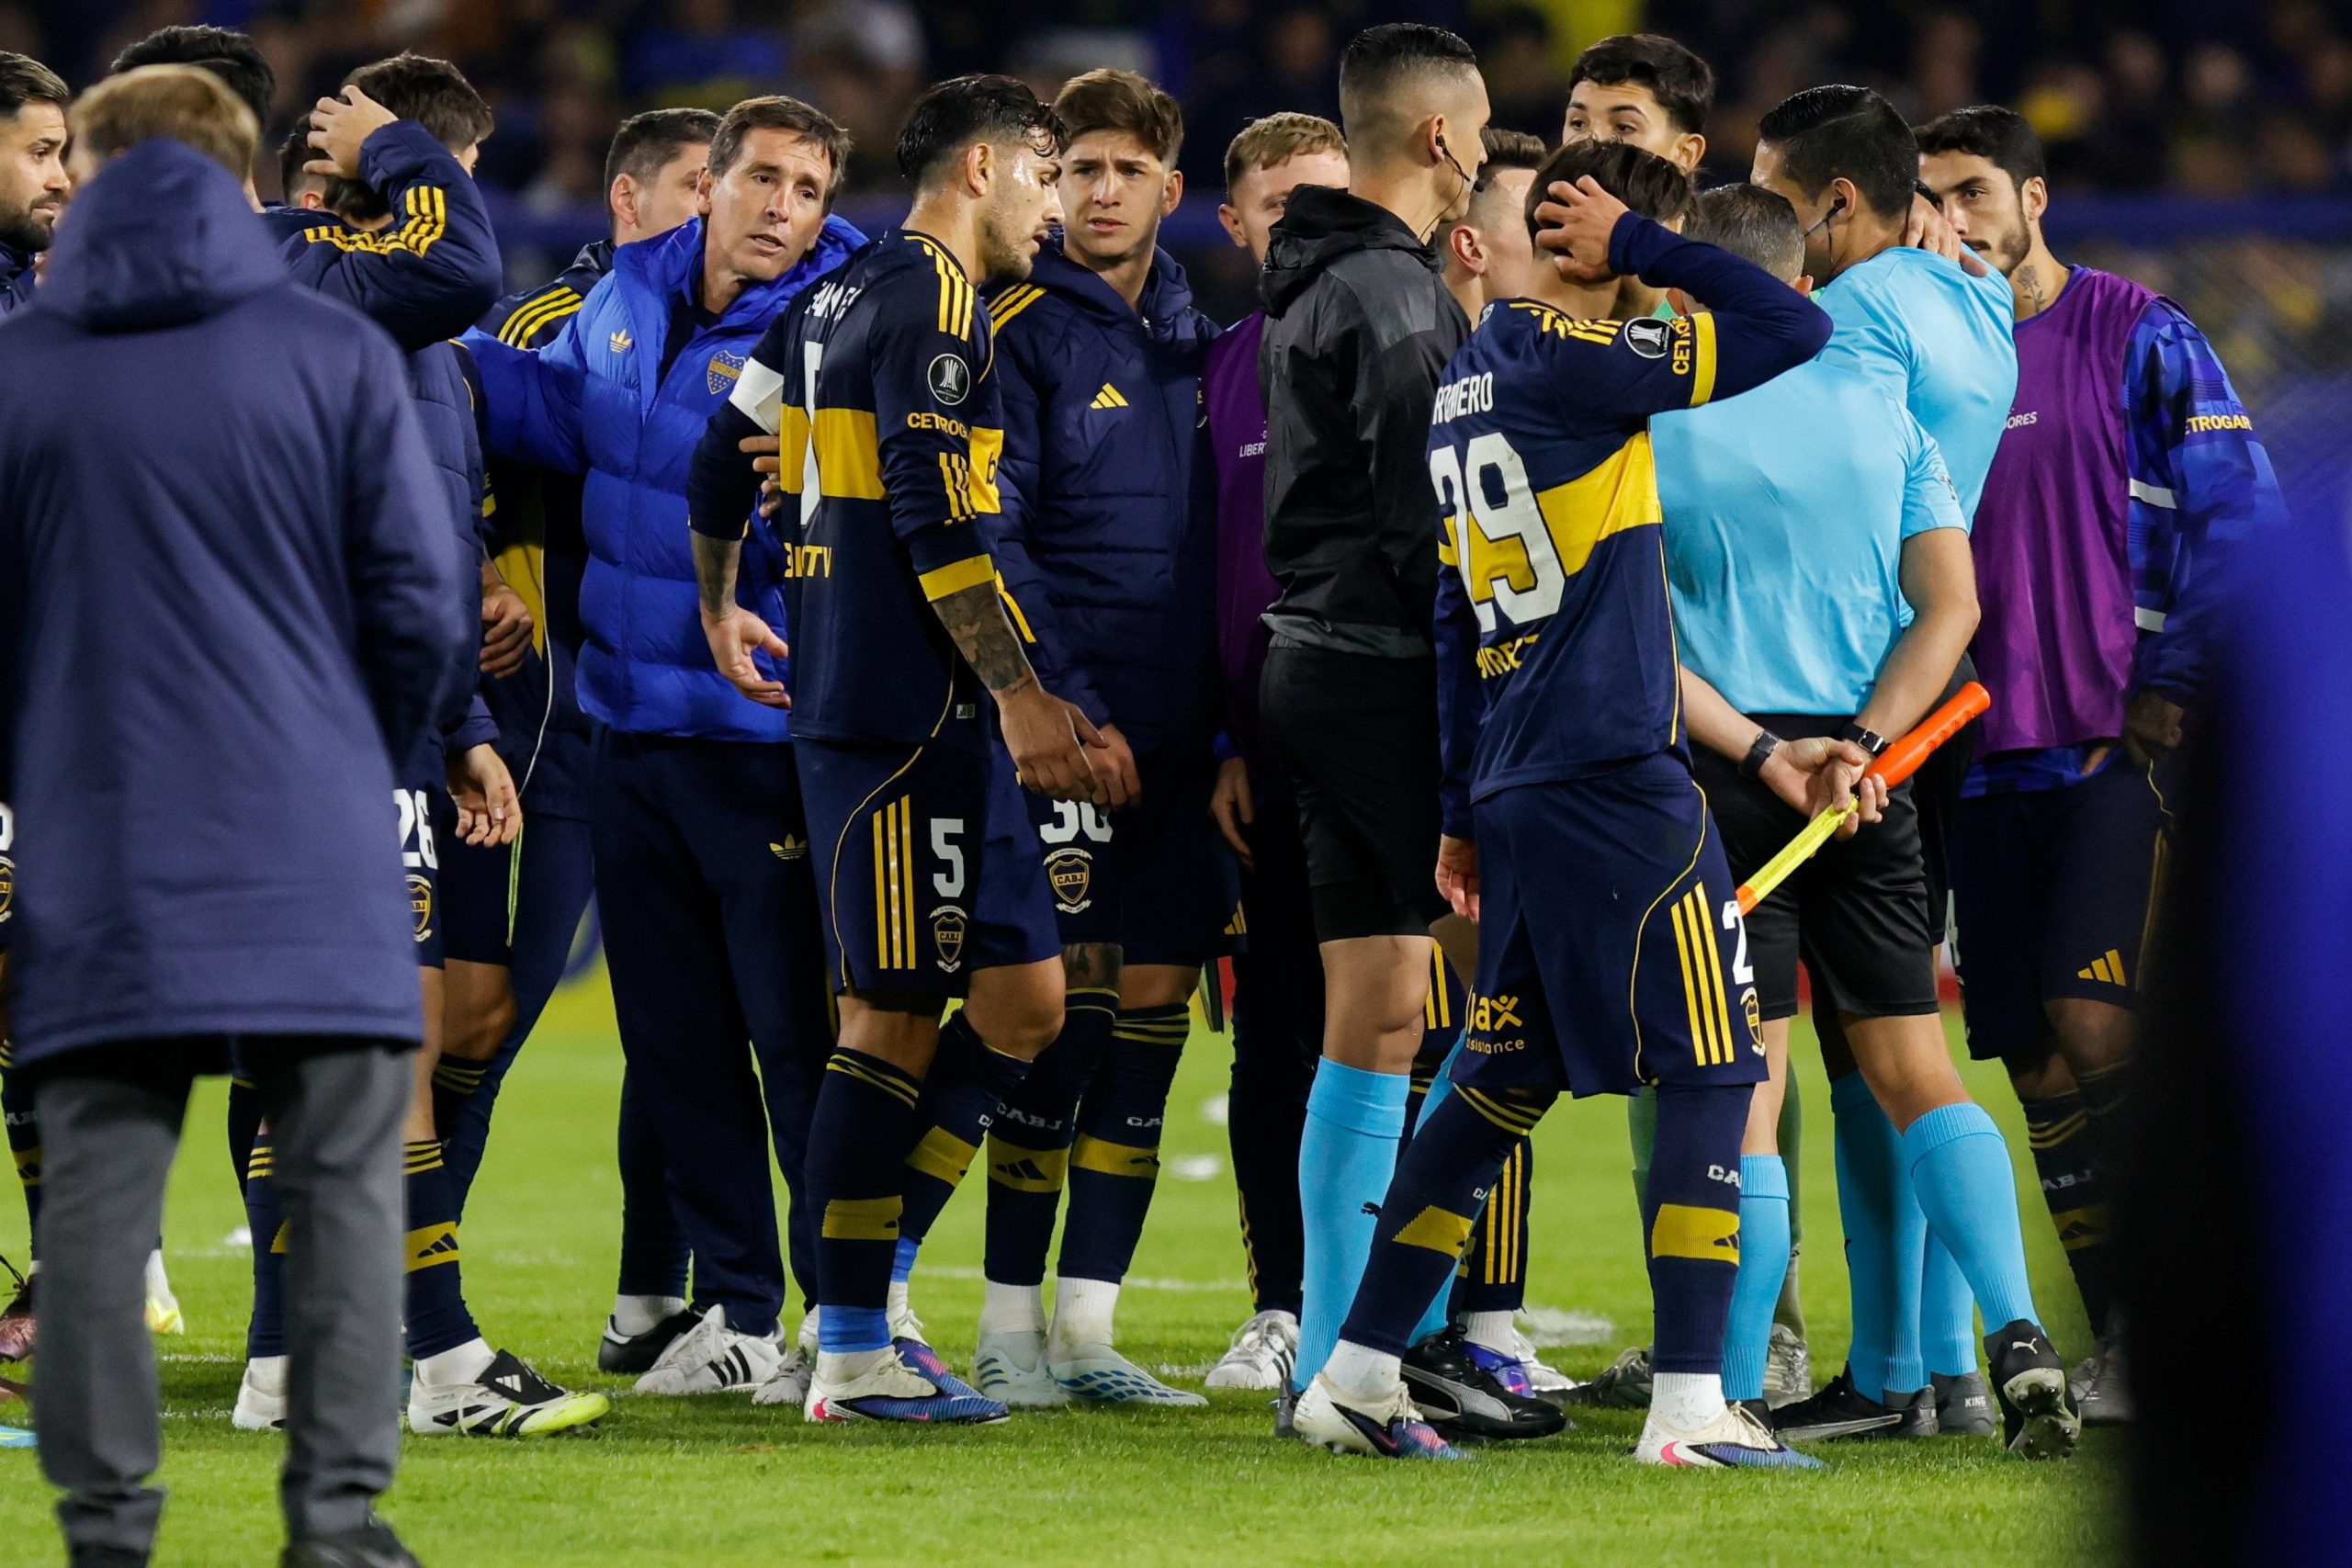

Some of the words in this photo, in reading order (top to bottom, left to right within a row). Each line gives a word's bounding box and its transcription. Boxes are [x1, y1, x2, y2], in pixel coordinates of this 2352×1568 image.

[1432, 371, 1493, 425] ROMERO
[907, 412, 970, 440] CETROG
[1239, 442, 1267, 457] LIBER
[931, 818, 965, 898] 5
[1057, 874, 1083, 884] CABJ
[940, 932, 960, 942] CABJ
[997, 1102, 1063, 1131] CABJ
[1965, 1395, 1986, 1408] KING
